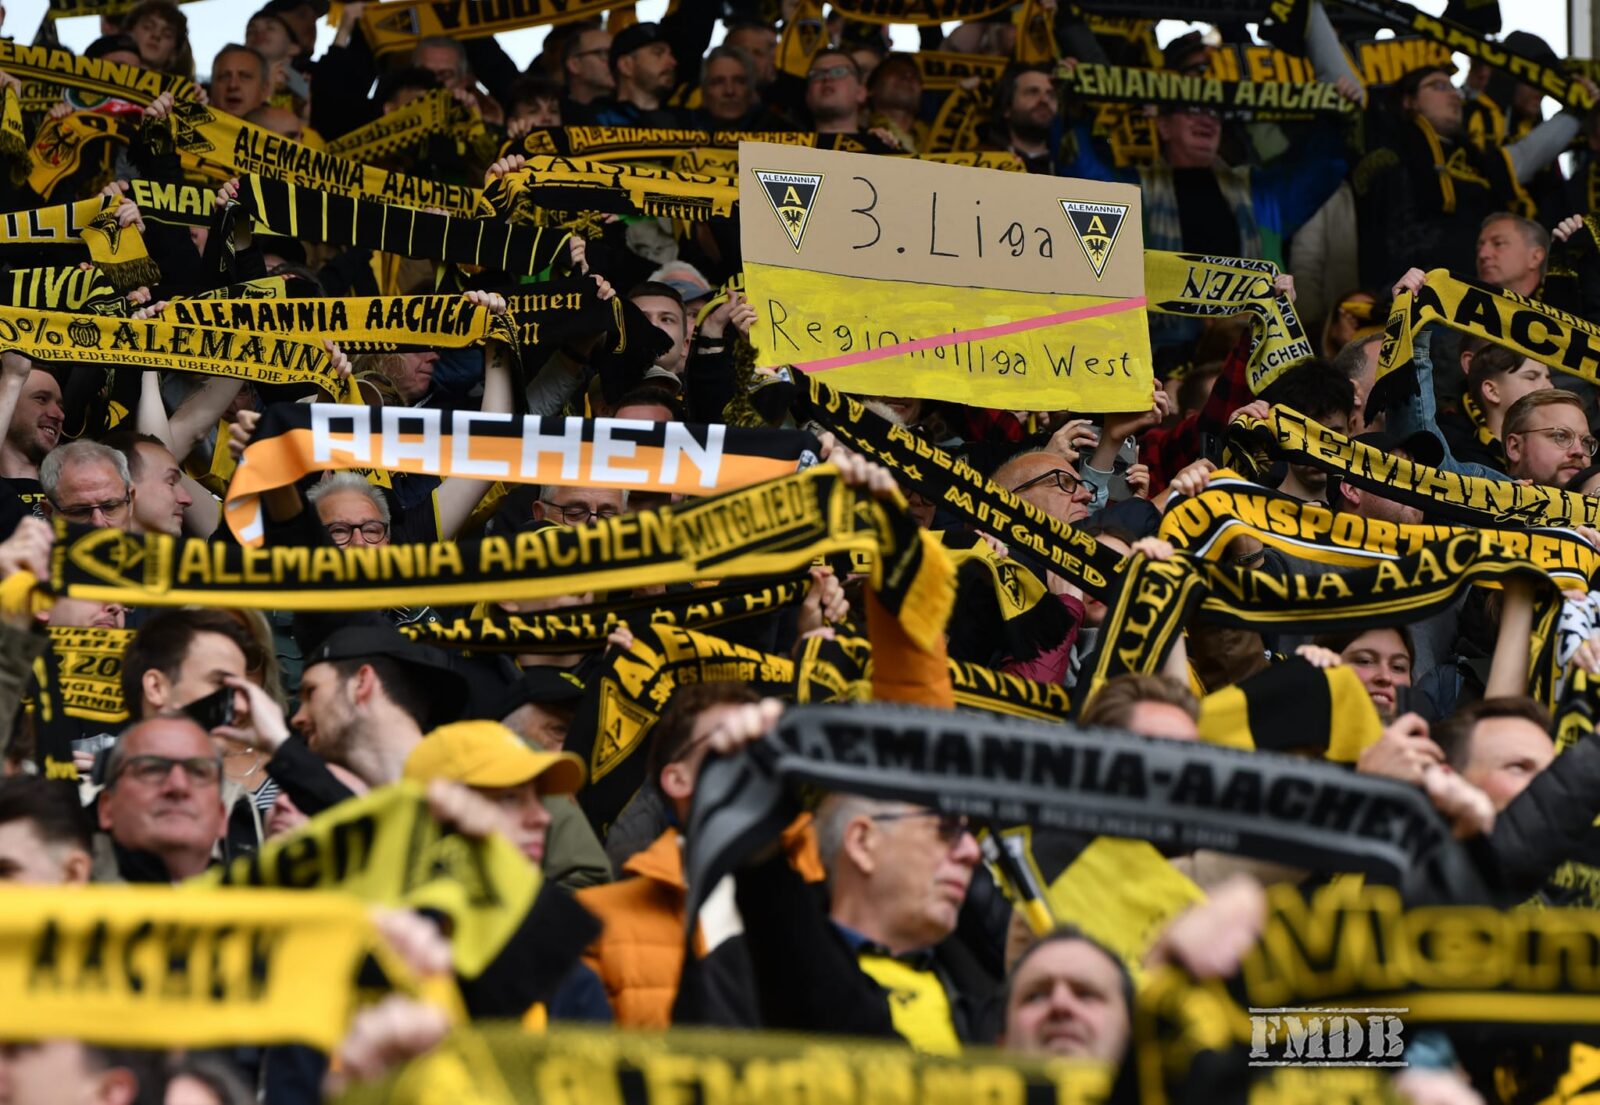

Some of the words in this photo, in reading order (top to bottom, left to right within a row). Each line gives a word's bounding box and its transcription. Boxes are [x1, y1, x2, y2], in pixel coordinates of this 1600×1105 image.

[1073, 63, 1224, 103] EMANNIA
[234, 126, 364, 189] ALEMANNIA
[383, 172, 475, 210] AACHEN
[234, 156, 287, 182] MEINE
[763, 174, 817, 185] ALEMANNIA
[929, 191, 1054, 259] Liga
[1067, 203, 1122, 214] ALEMANNIA
[174, 300, 348, 332] ALEMANNIA
[366, 297, 476, 336] AACHEN
[32, 348, 74, 360] ODER
[77, 352, 173, 367] EDENKOBEN
[257, 369, 283, 383] DIE
[1044, 343, 1132, 378] West
[1251, 341, 1311, 385] AACHEN
[311, 402, 727, 489] AACHEN
[887, 423, 1099, 558] ALEMANNIA
[177, 537, 465, 586] ALEMANNIA
[478, 507, 680, 573] AACHEN
[680, 480, 807, 560] MITGLIED
[943, 484, 1108, 588] MITGLIED
